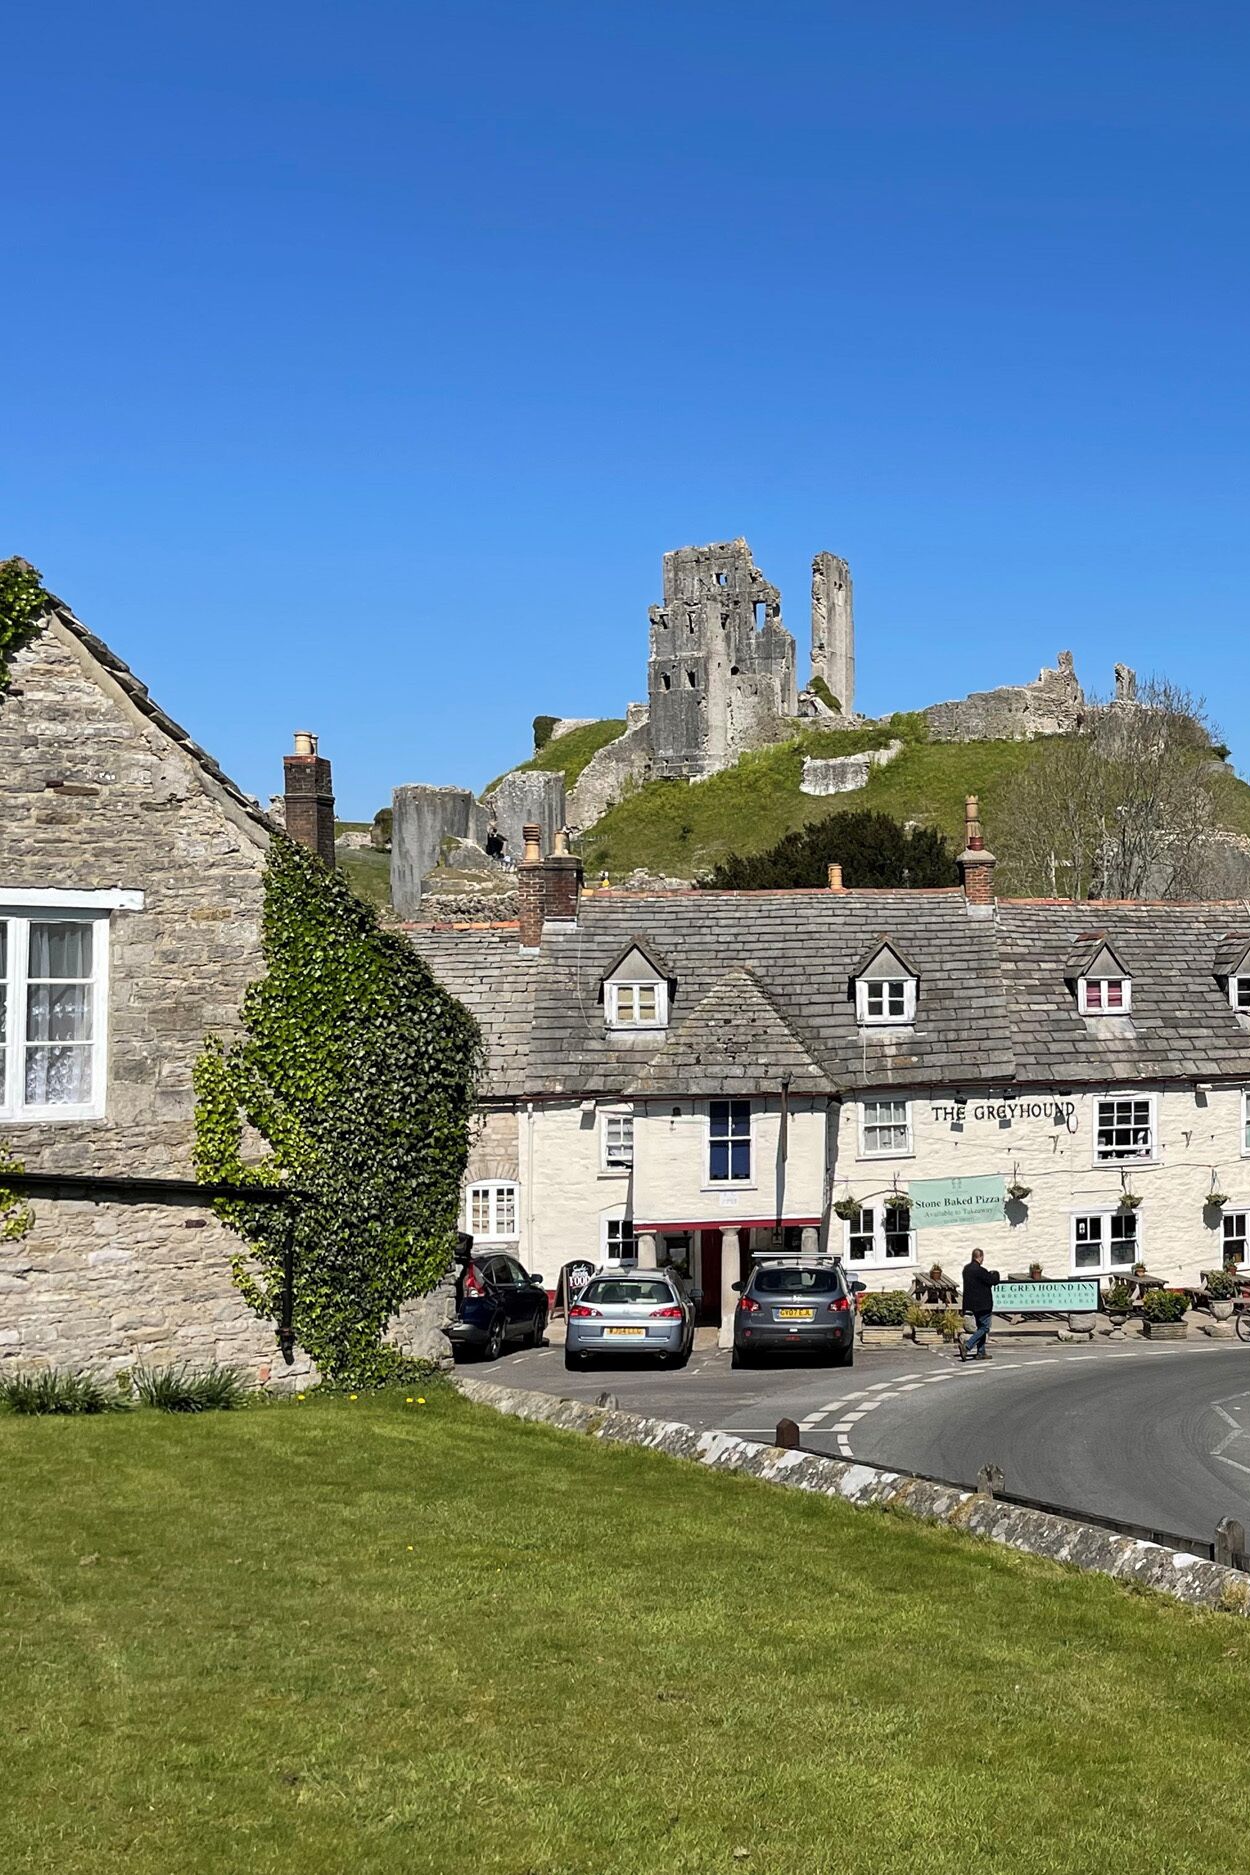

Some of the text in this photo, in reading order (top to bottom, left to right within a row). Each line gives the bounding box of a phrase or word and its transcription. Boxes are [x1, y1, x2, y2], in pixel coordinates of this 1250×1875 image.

[931, 1102, 1075, 1121] THE GREYHOUND
[915, 1195, 1000, 1209] Stone Baked Pizza
[1010, 1283, 1074, 1292] GREYHOUND
[1077, 1283, 1095, 1291] INN
